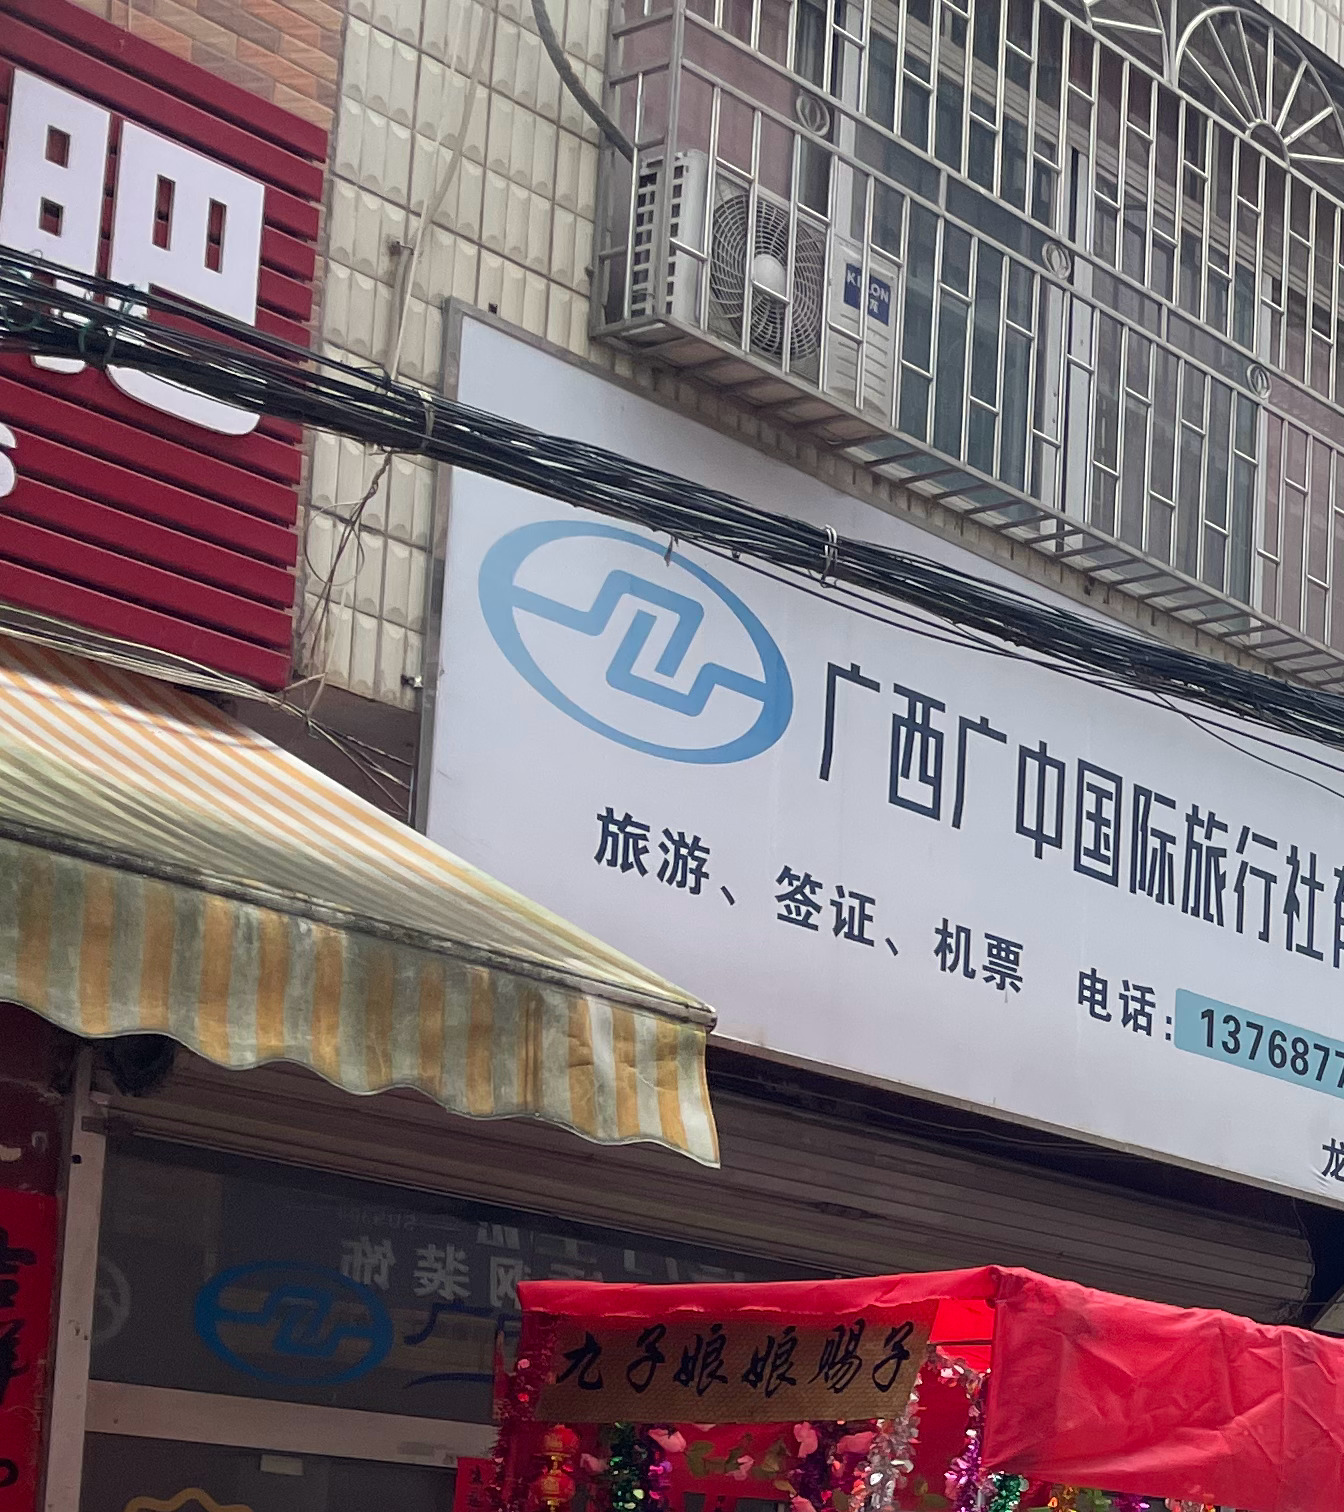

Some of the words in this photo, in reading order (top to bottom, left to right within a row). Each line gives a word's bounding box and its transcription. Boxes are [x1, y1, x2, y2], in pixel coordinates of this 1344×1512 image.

[594, 808, 1024, 994] 旅游、签证、机票
